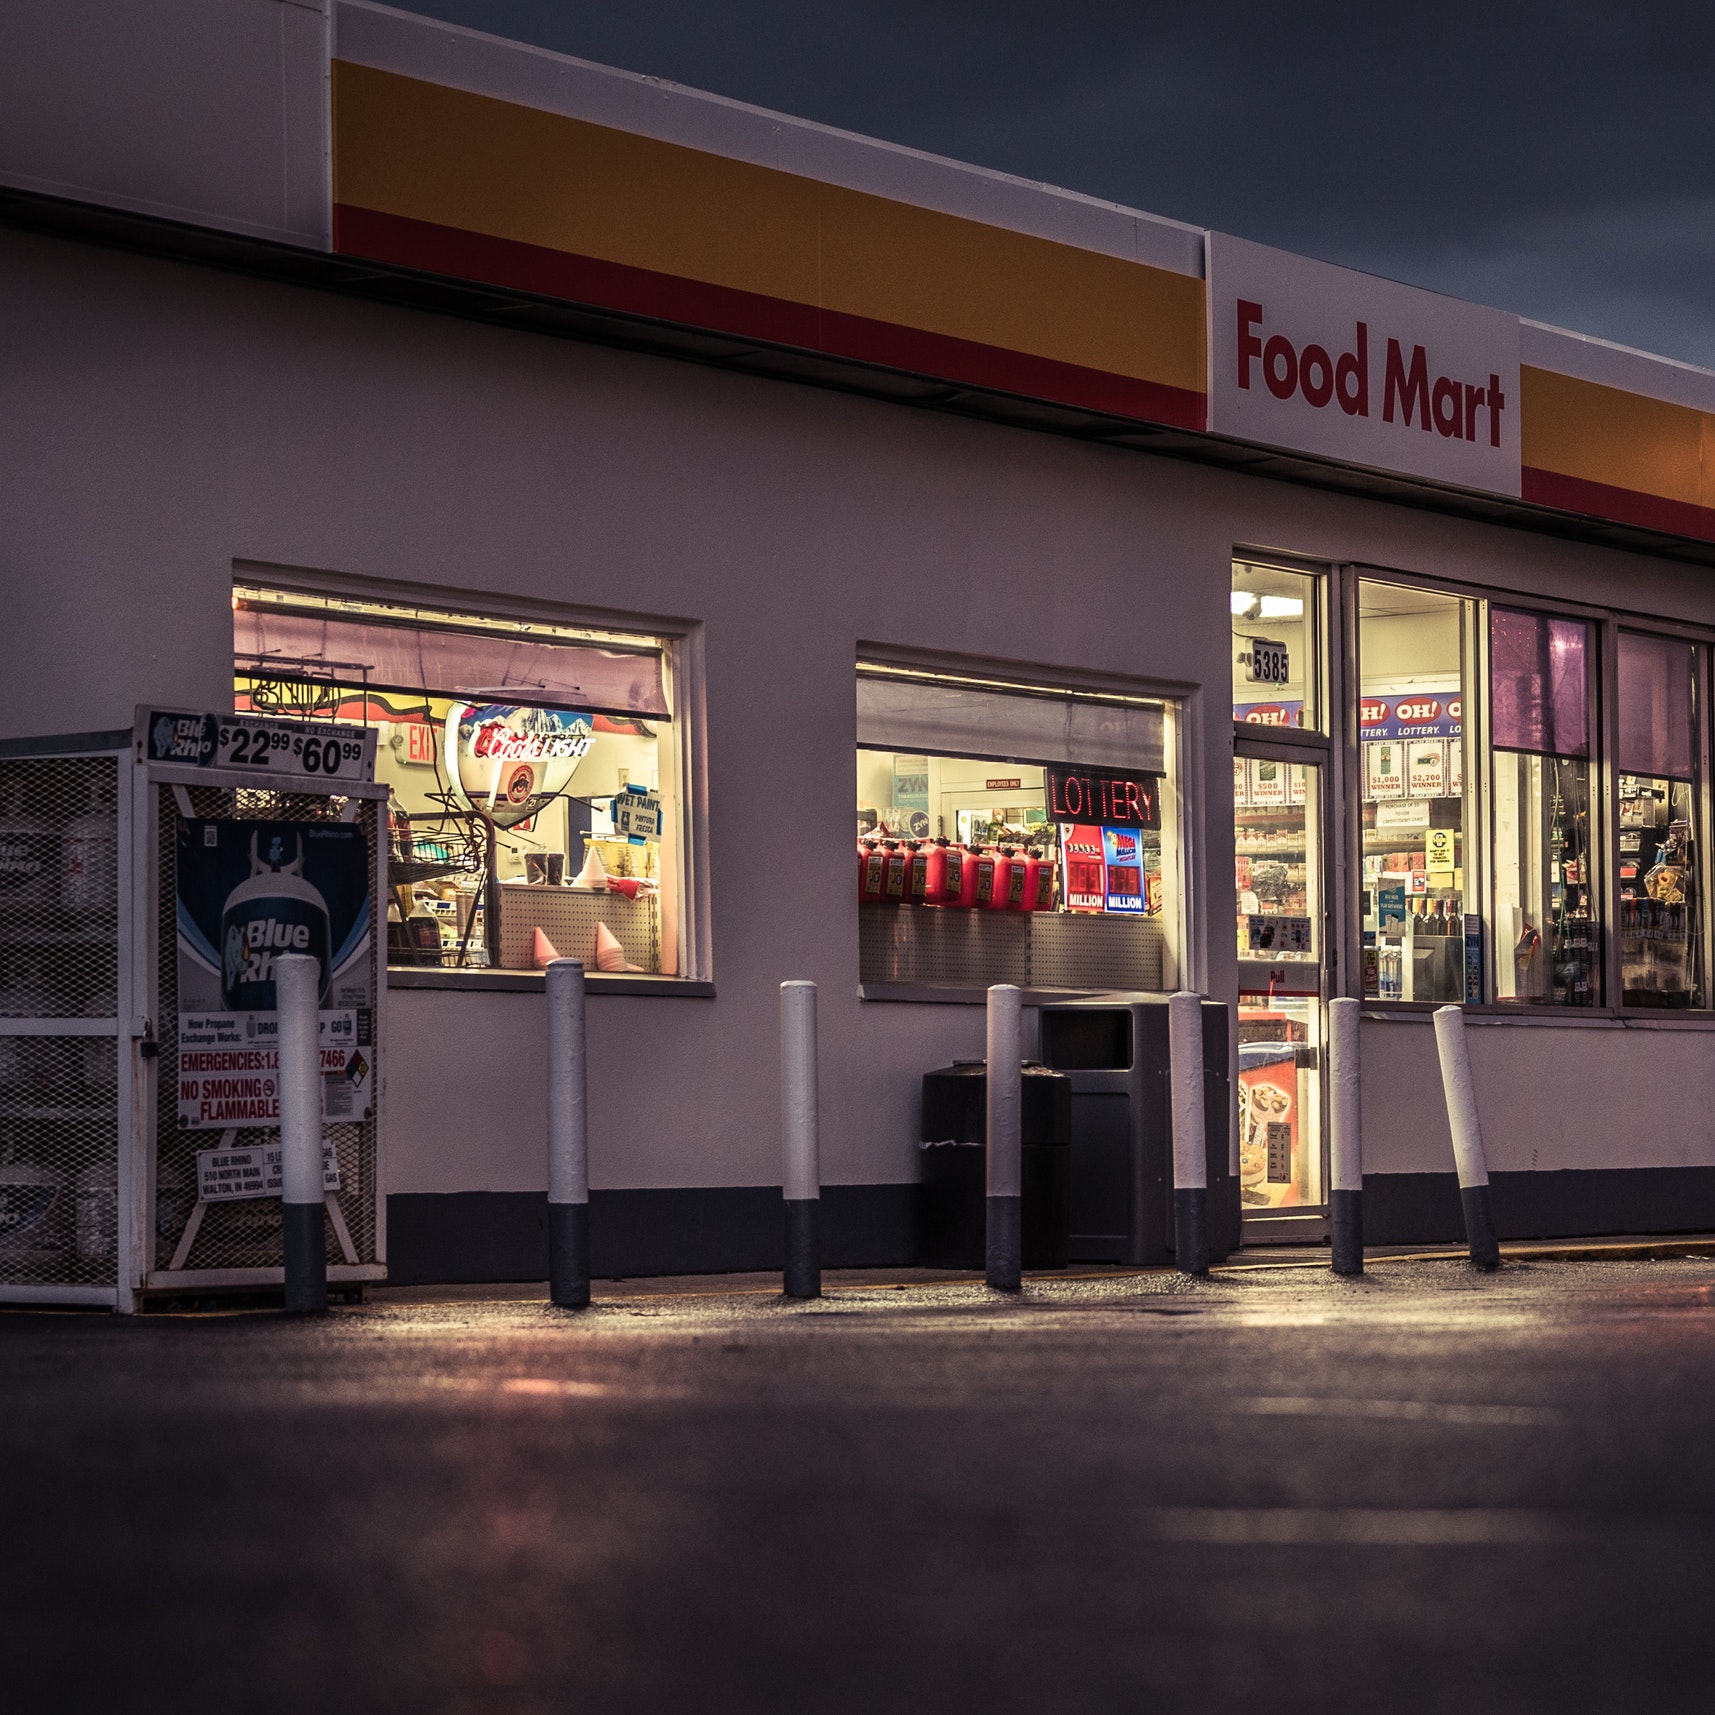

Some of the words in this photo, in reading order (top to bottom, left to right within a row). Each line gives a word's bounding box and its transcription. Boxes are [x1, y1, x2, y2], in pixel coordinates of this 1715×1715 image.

[1237, 299, 1369, 417] Food
[1383, 338, 1505, 448] Mart
[1254, 650, 1289, 683] 5385
[1361, 703, 1386, 720] H!
[1396, 701, 1437, 719] OH!
[239, 719, 280, 730] EXCHANGE
[1397, 726, 1438, 736] LOTTERY
[304, 725, 316, 734] NO
[317, 727, 356, 739] EXCHANGE
[1361, 728, 1388, 737] TTERY
[409, 725, 437, 761] EXIT
[898, 777, 928, 793] ZYN
[987, 780, 1009, 788] EMPLOYEES
[1372, 776, 1399, 784] $1,000
[1412, 774, 1440, 782] $2,700
[617, 793, 635, 807] WET
[637, 796, 660, 812] PAINT
[1051, 774, 1152, 821] LOTTERY
[913, 817, 929, 832] ZYN
[1069, 894, 1103, 907] MILLION
[1108, 896, 1142, 909] MILLION
[247, 917, 309, 949] Blue
[1270, 970, 1285, 983] Pull
[188, 1019, 203, 1029] How
[205, 1019, 235, 1030] Propane
[331, 1020, 342, 1033] GO
[181, 1033, 215, 1045] Exchange
[217, 1031, 242, 1043] Works:
[181, 1080, 199, 1101] NO
[202, 1078, 261, 1099] SMOKING
[201, 1099, 279, 1121] FLAMMABLE
[212, 1156, 230, 1168] BLUE
[230, 1154, 252, 1166] RHINO
[204, 1171, 218, 1182] 510
[218, 1169, 241, 1180] NORTH
[242, 1167, 260, 1178] MAIN
